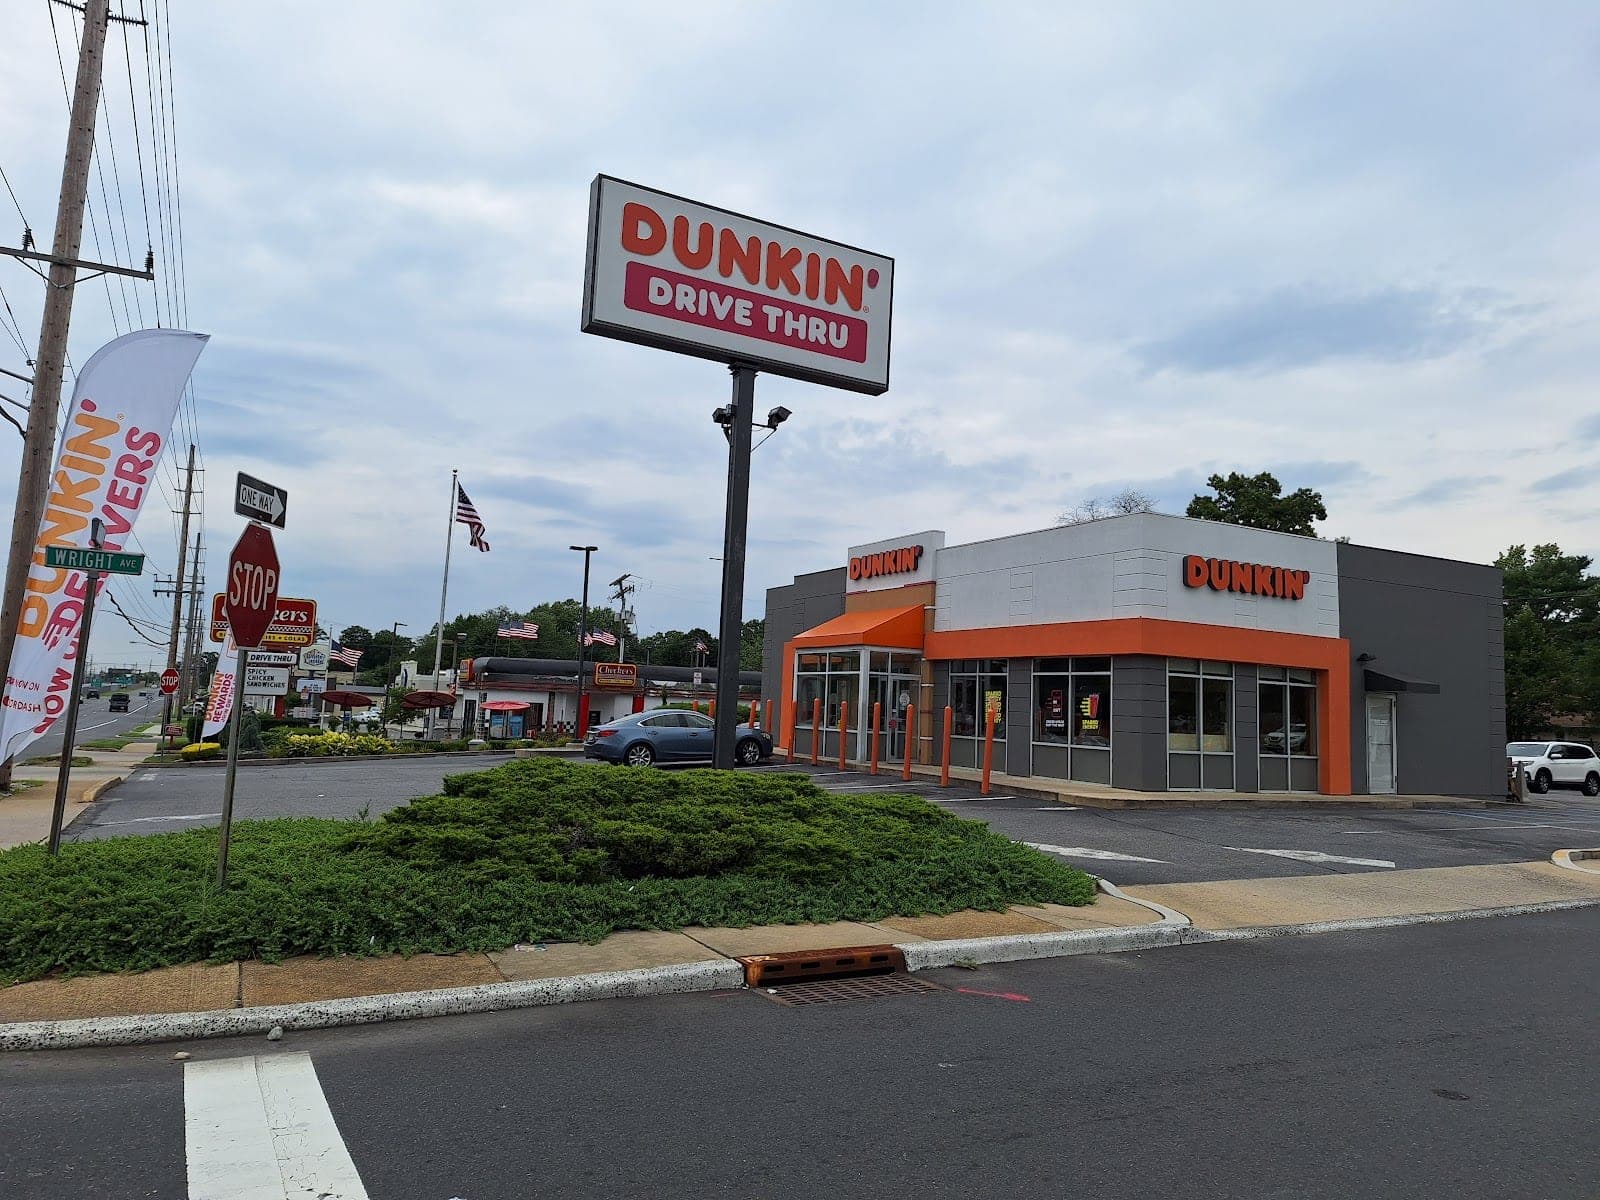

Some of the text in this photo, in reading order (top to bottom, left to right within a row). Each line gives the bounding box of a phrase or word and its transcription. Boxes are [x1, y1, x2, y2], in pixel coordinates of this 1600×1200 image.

[621, 202, 879, 312] DUNKIN'
[648, 276, 849, 349] DRIVE THRU
[241, 487, 274, 513] ONE WAY
[55, 549, 137, 570] WRIGHT AVE
[849, 545, 923, 580] DUNKIN'
[230, 560, 276, 611] STOP
[1182, 555, 1310, 600] DUNKIN'
[250, 654, 293, 663] DRIVE THRU
[28, 682, 40, 691] ON
[161, 676, 178, 686] STOP
[246, 681, 286, 689] SANDWICHES
[212, 673, 233, 722] REWARDS
